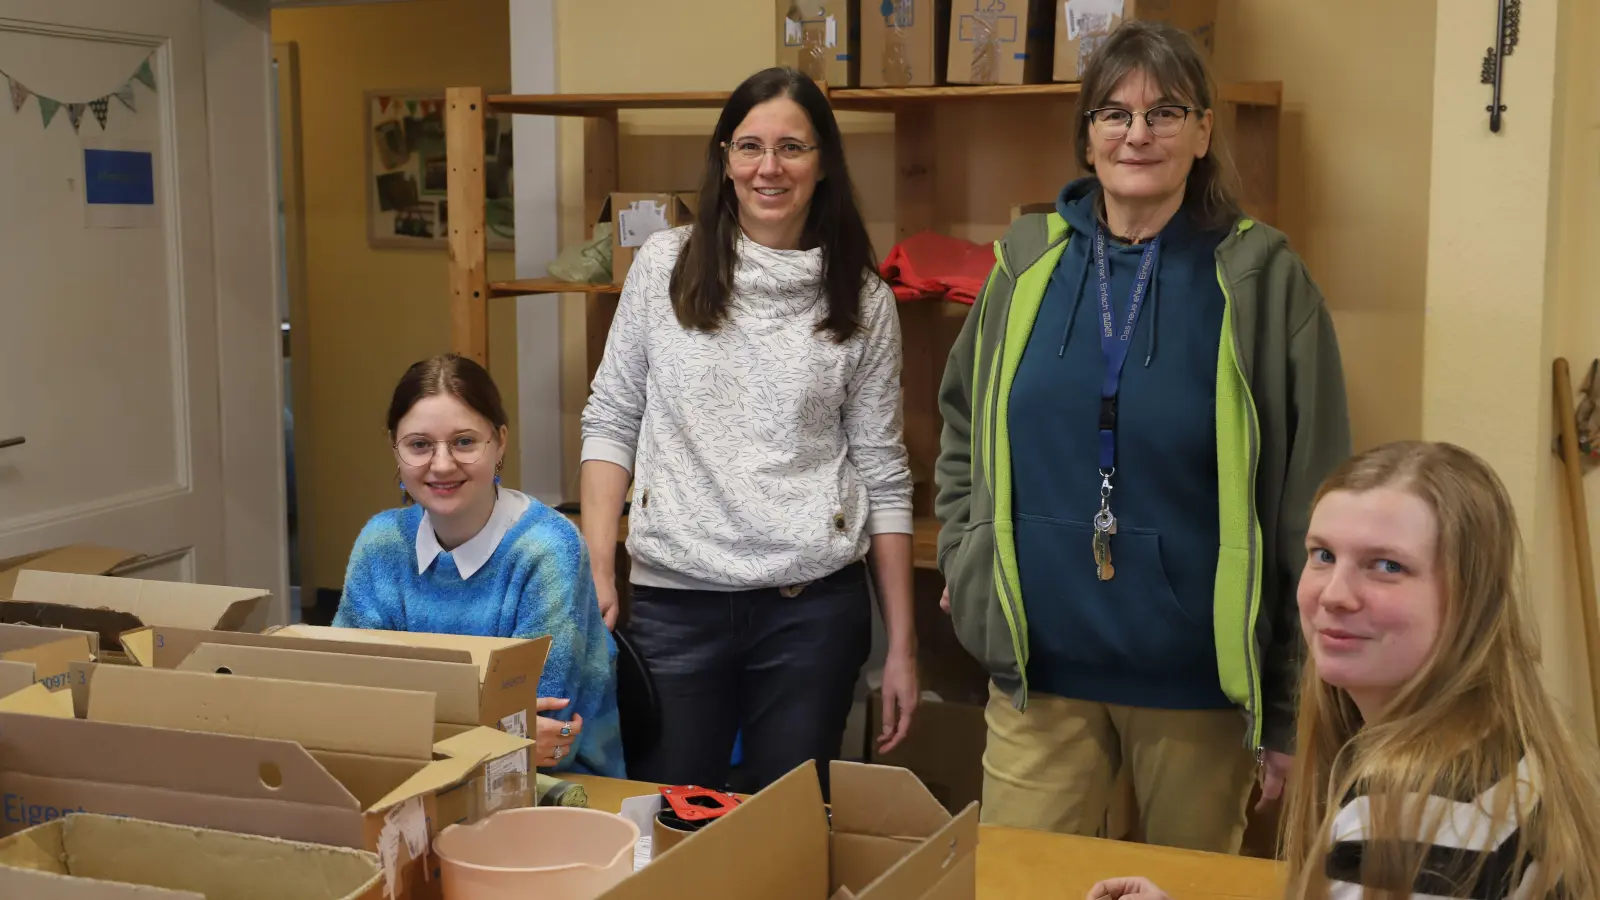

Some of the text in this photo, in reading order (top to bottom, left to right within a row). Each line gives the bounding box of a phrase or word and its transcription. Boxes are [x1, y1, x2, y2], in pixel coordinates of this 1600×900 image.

[1100, 282, 1109, 311] Einfach
[1120, 325, 1132, 340] Das
[1127, 303, 1138, 324] neue
[1138, 251, 1153, 280] Einfach
[156, 634, 165, 648] 3
[78, 669, 86, 684] 3
